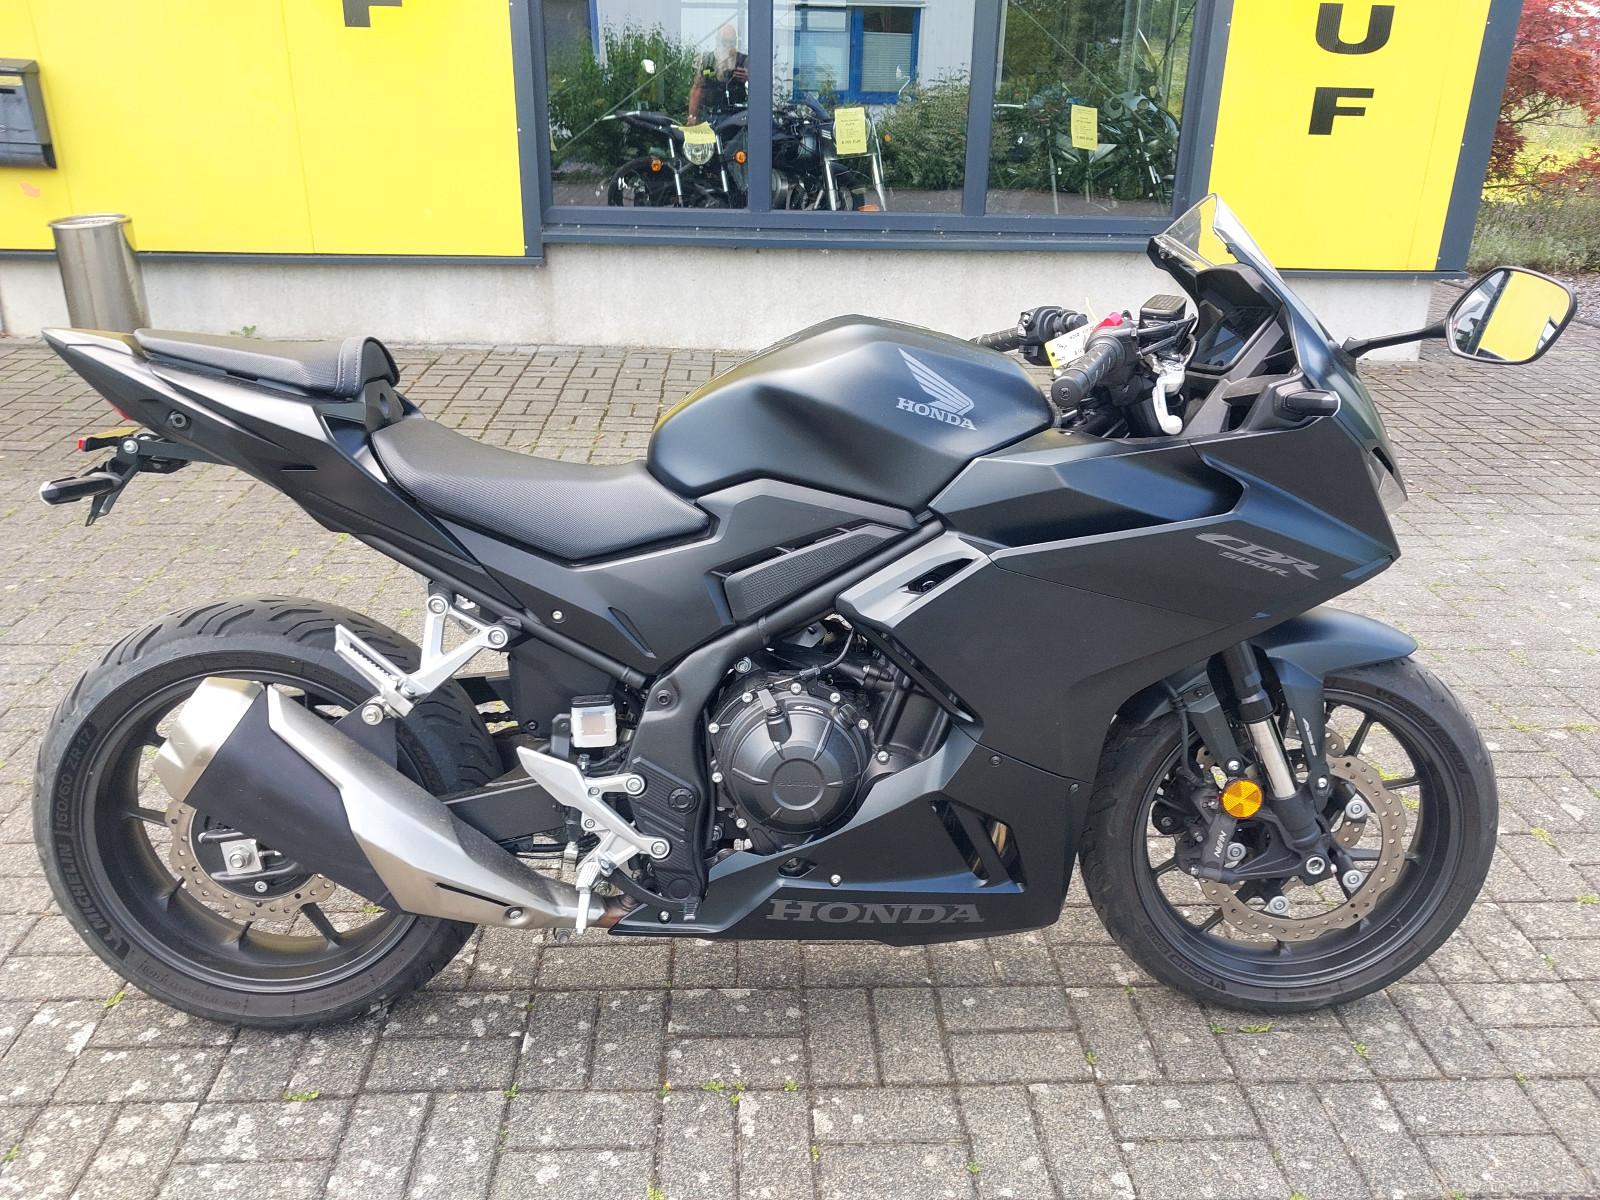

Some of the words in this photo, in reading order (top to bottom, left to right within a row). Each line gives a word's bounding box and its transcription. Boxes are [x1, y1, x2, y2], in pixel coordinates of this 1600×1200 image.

[896, 397, 977, 431] HONDA
[1195, 533, 1320, 581] CBR
[58, 842, 108, 931] MICHELIN
[766, 898, 985, 924] HONDA
